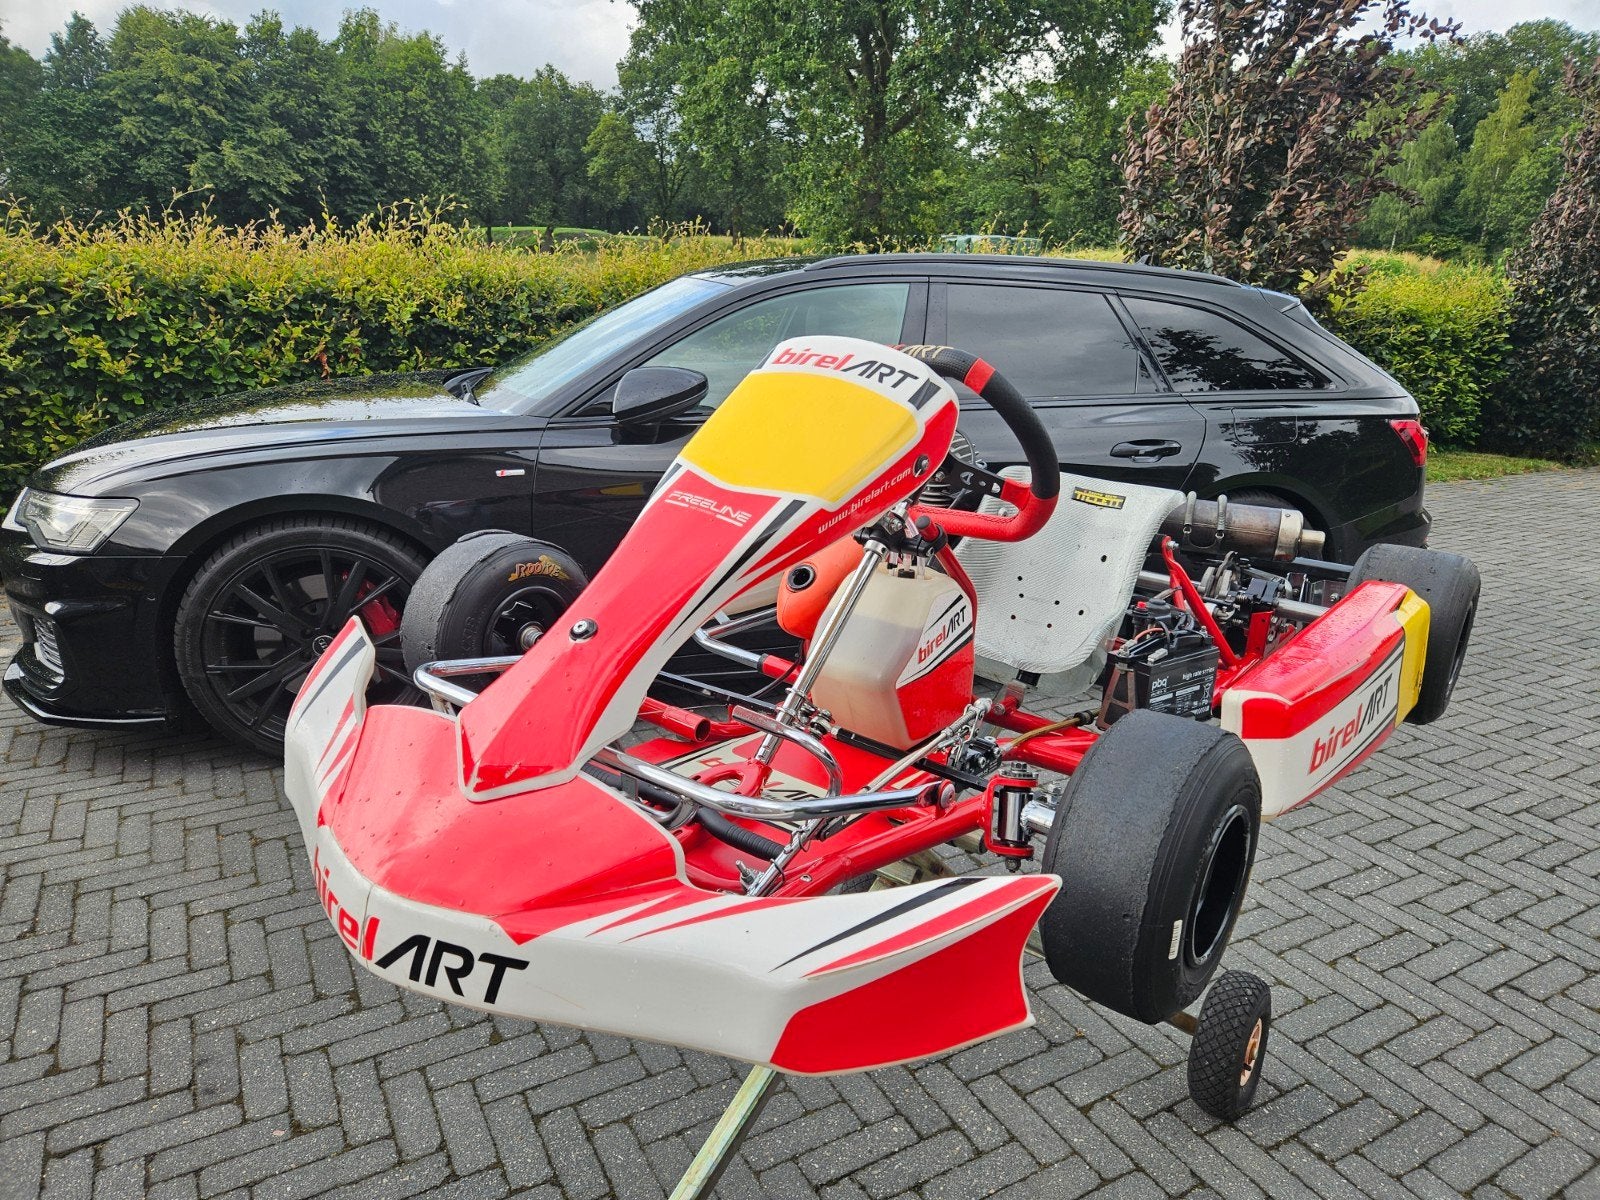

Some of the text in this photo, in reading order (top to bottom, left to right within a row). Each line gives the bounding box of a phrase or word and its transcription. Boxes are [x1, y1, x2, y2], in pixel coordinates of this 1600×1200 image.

[772, 347, 919, 389] birelART
[668, 490, 752, 524] FREELINE
[817, 467, 911, 535] www.birelart.com
[917, 604, 967, 664] birelART
[1151, 677, 1167, 691] pbq
[1307, 673, 1393, 776] birelART
